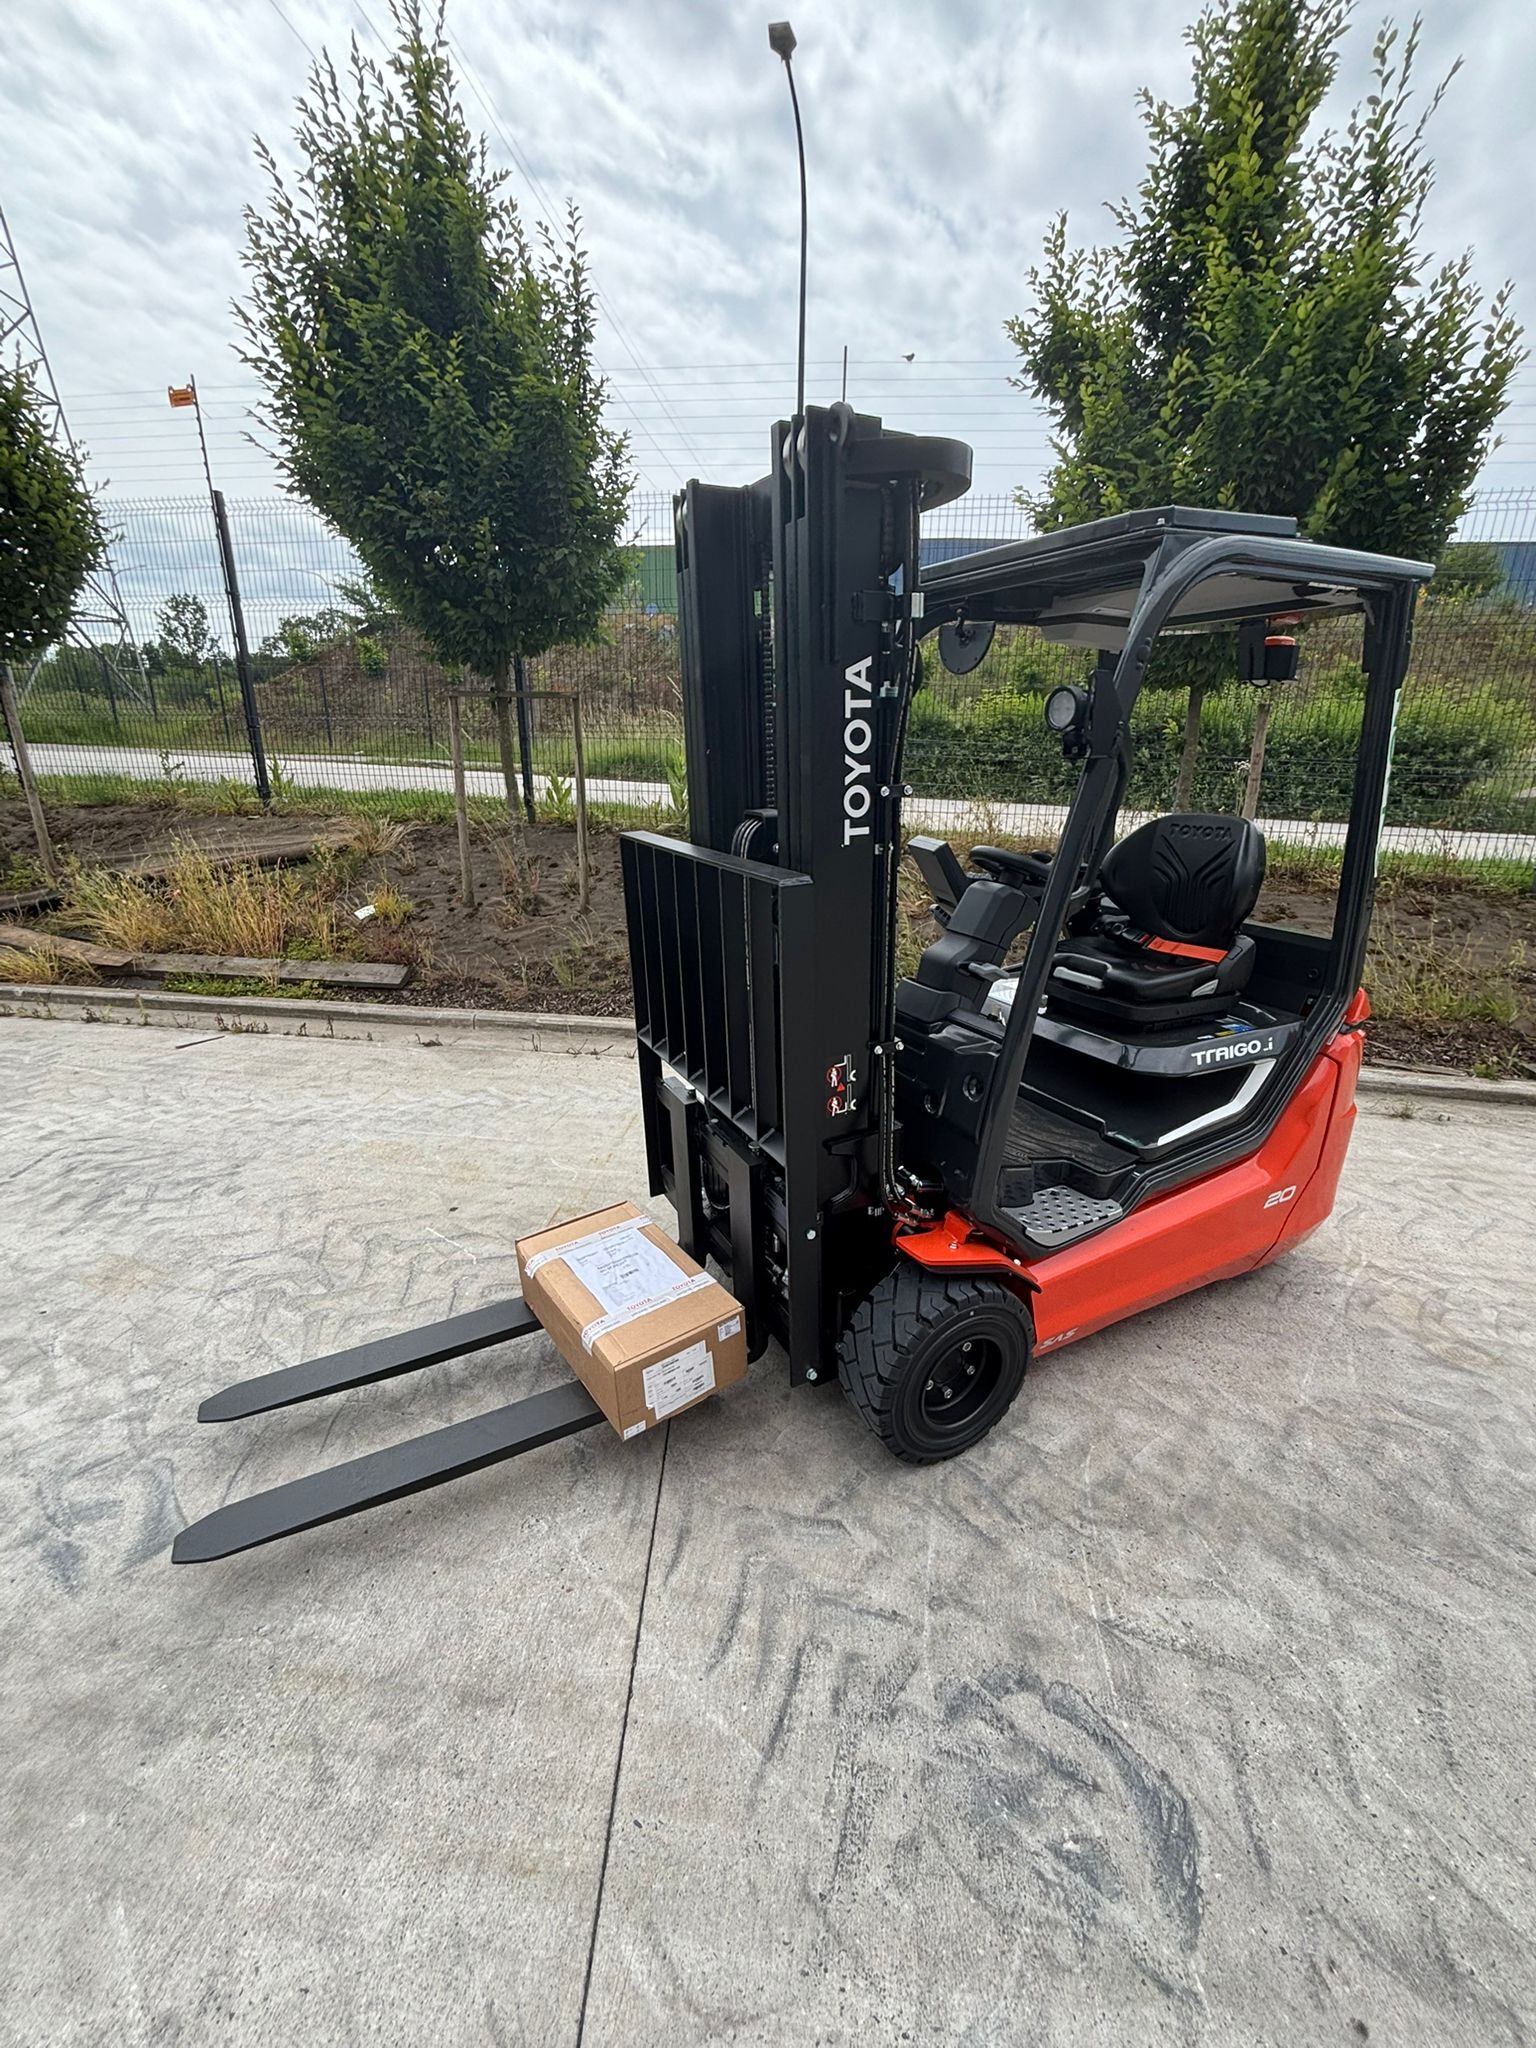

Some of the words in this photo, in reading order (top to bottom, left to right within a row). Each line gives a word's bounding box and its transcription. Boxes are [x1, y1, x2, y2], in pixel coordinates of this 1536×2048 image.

[844, 656, 872, 845] TOYOTA
[1169, 823, 1232, 840] TOYOTA
[1263, 1185, 1297, 1209] 20
[672, 1278, 696, 1292] TOYOTA
[626, 1297, 653, 1312] TOYOTA
[1039, 1327, 1079, 1350] SAS
